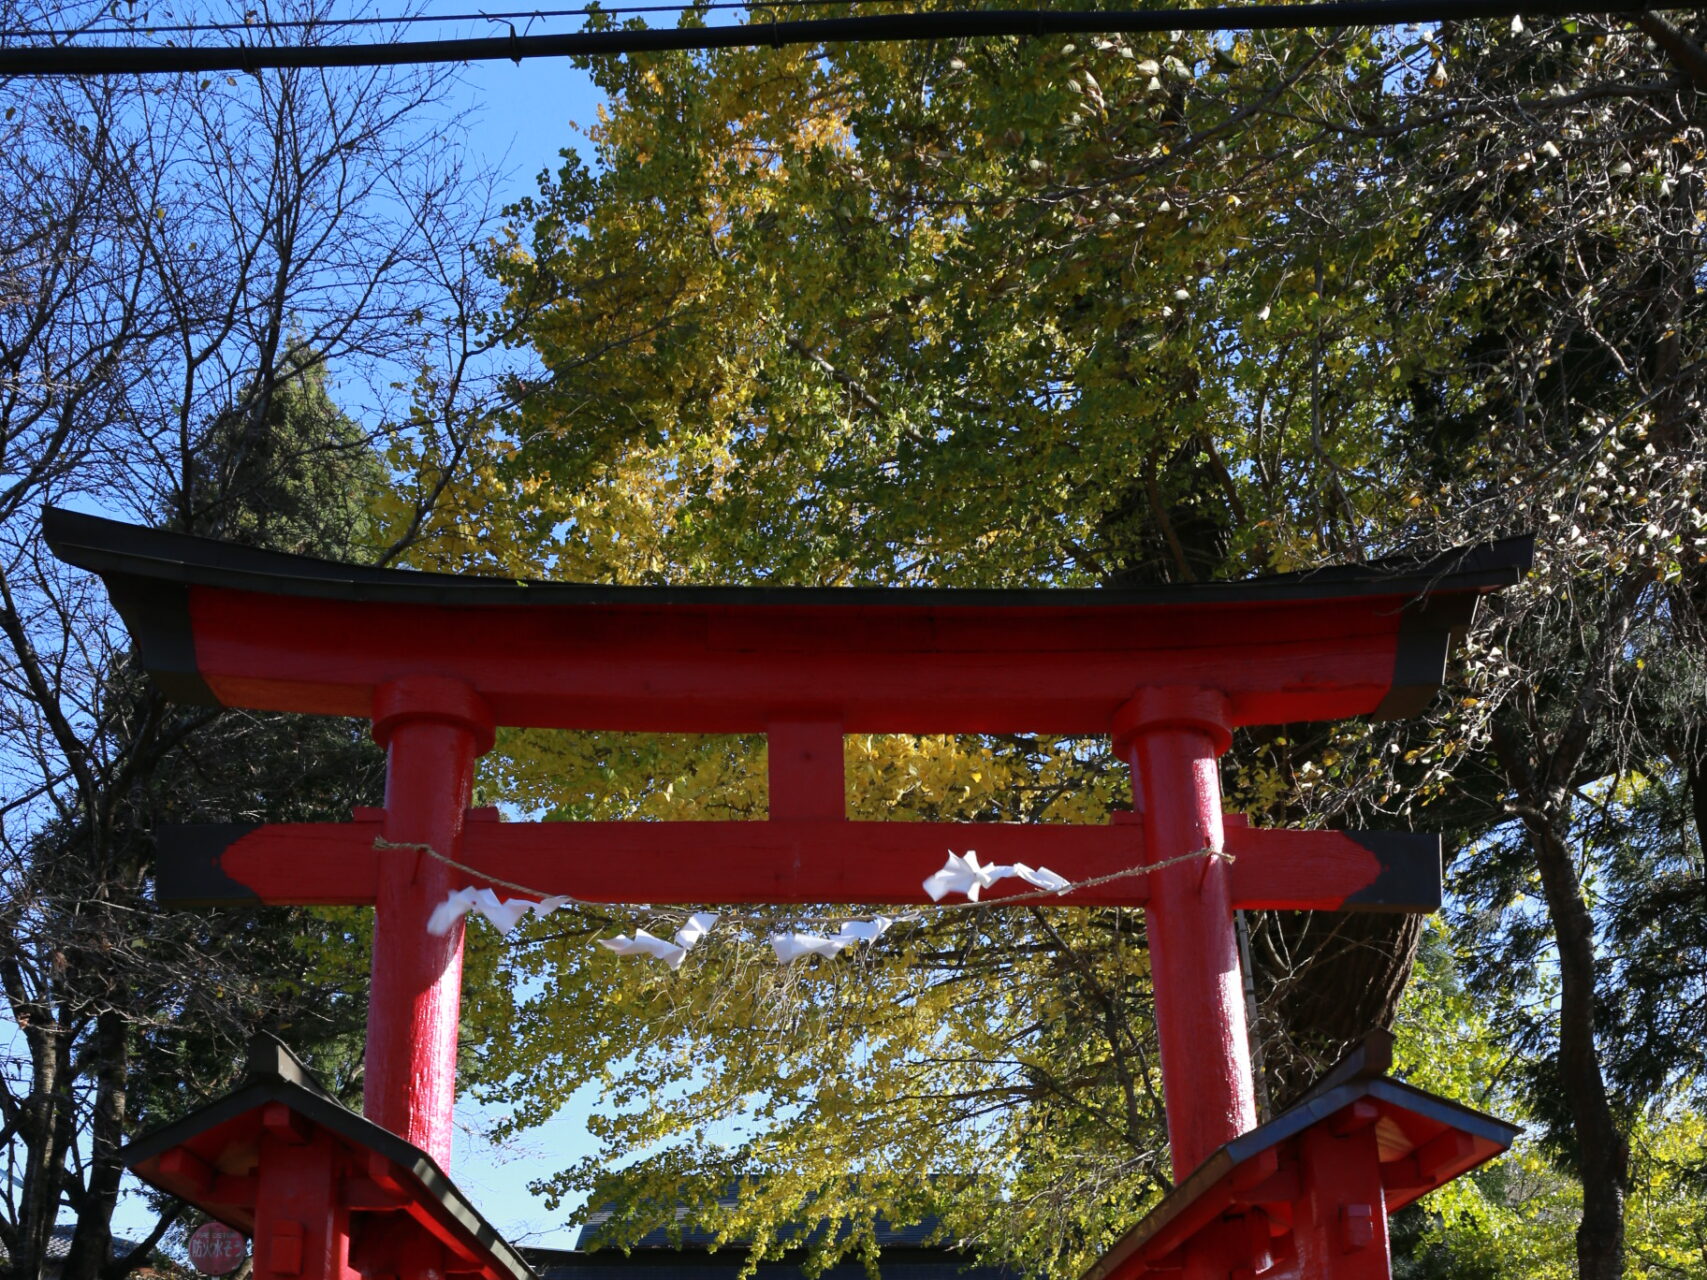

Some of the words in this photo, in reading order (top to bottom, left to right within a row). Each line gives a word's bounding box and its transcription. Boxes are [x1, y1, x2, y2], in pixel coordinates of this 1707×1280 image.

[192, 1239, 242, 1258] 防火水そう
